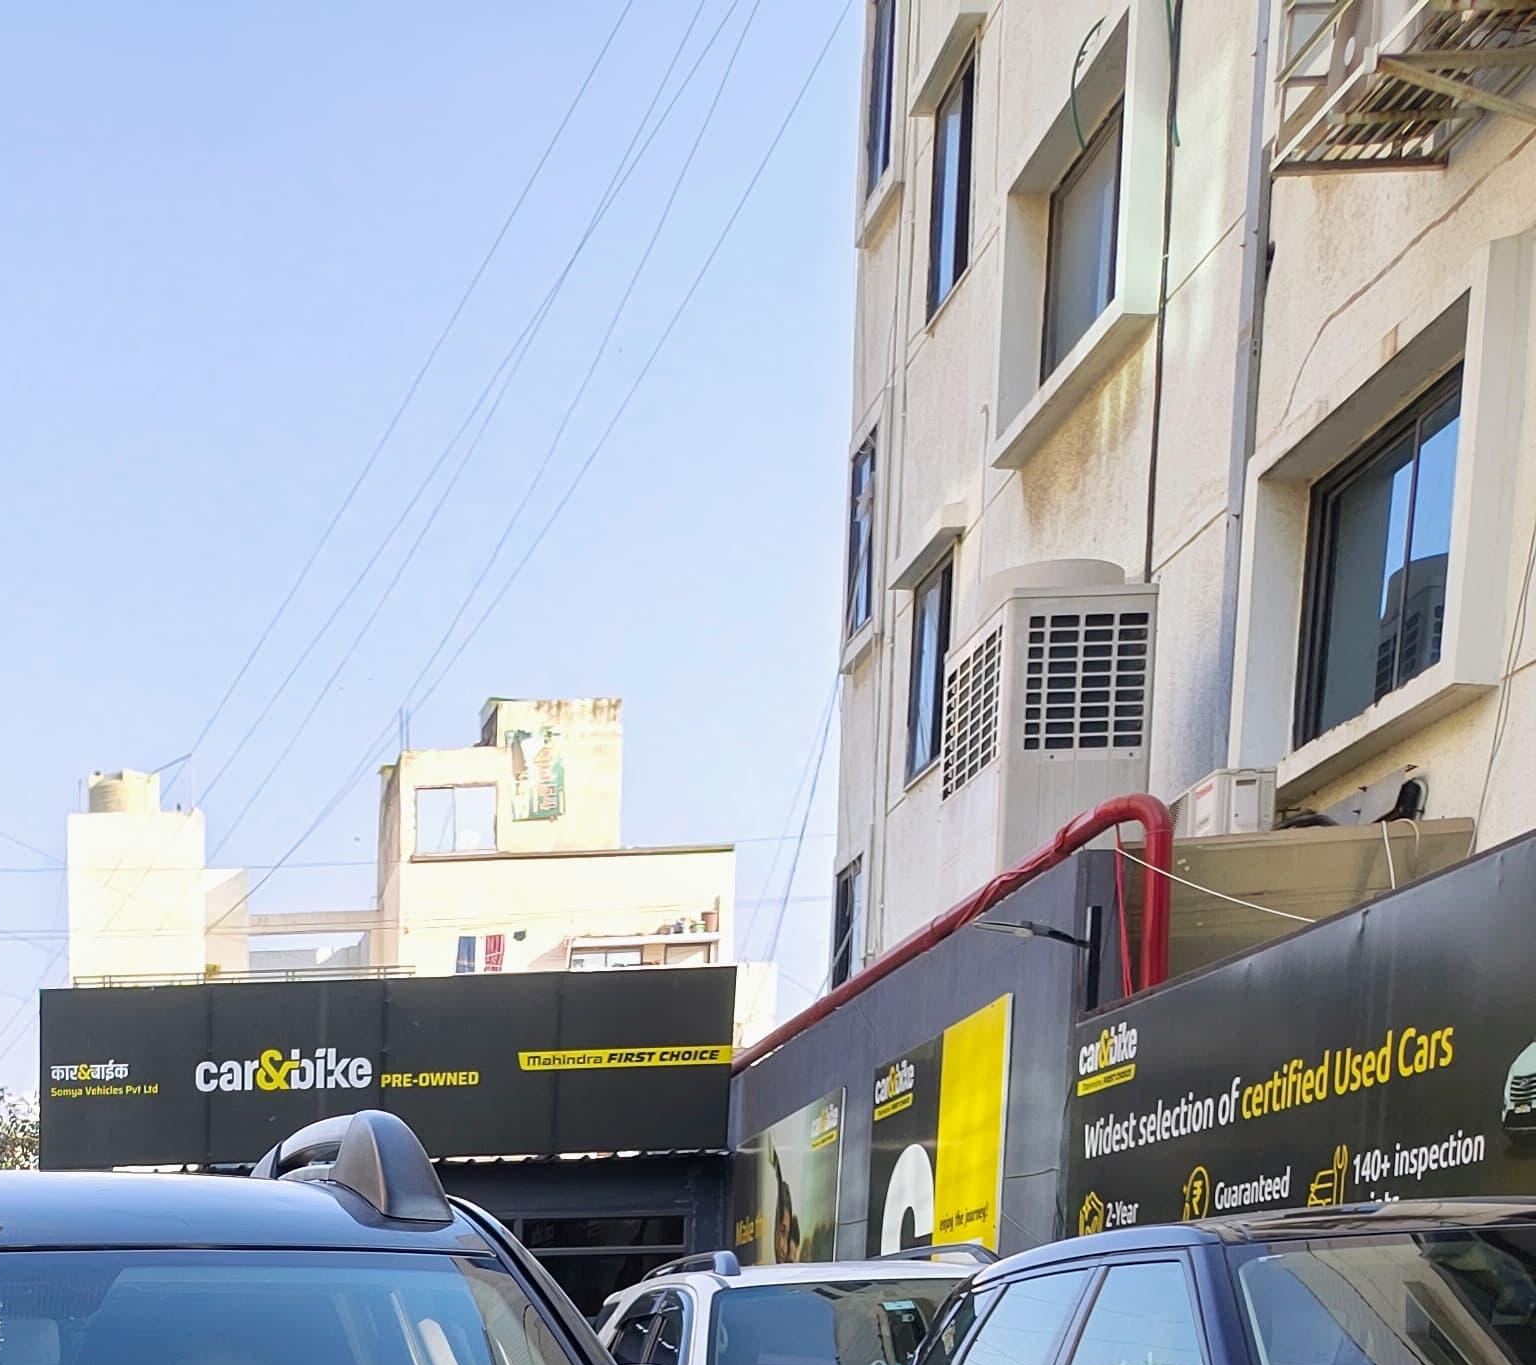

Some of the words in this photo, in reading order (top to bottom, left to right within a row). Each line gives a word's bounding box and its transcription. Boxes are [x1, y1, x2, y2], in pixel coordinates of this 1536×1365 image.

[195, 1047, 373, 1092] car&bike
[380, 1071, 480, 1087] PRE-OWNED
[527, 1053, 603, 1066] Mahindra
[607, 1051, 656, 1063] FIRST
[659, 1050, 719, 1062] CHOICE
[1079, 1021, 1137, 1076] car&bike
[50, 1087, 83, 1098] Somya
[85, 1085, 124, 1095] Vehicles
[126, 1085, 141, 1095] Pvt
[143, 1083, 159, 1094] Ltd
[1084, 1112, 1136, 1159] Widest
[1138, 1092, 1214, 1146] selection
[1218, 1077, 1241, 1126] of
[1241, 1049, 1330, 1119] certified
[1334, 1030, 1393, 1095] Used
[1398, 1026, 1454, 1077] Cars
[1353, 1149, 1391, 1185] 140+
[1394, 1129, 1485, 1180] inspection
[1214, 1165, 1291, 1210] Guaranteed
[1105, 1201, 1139, 1227] 2-Year
